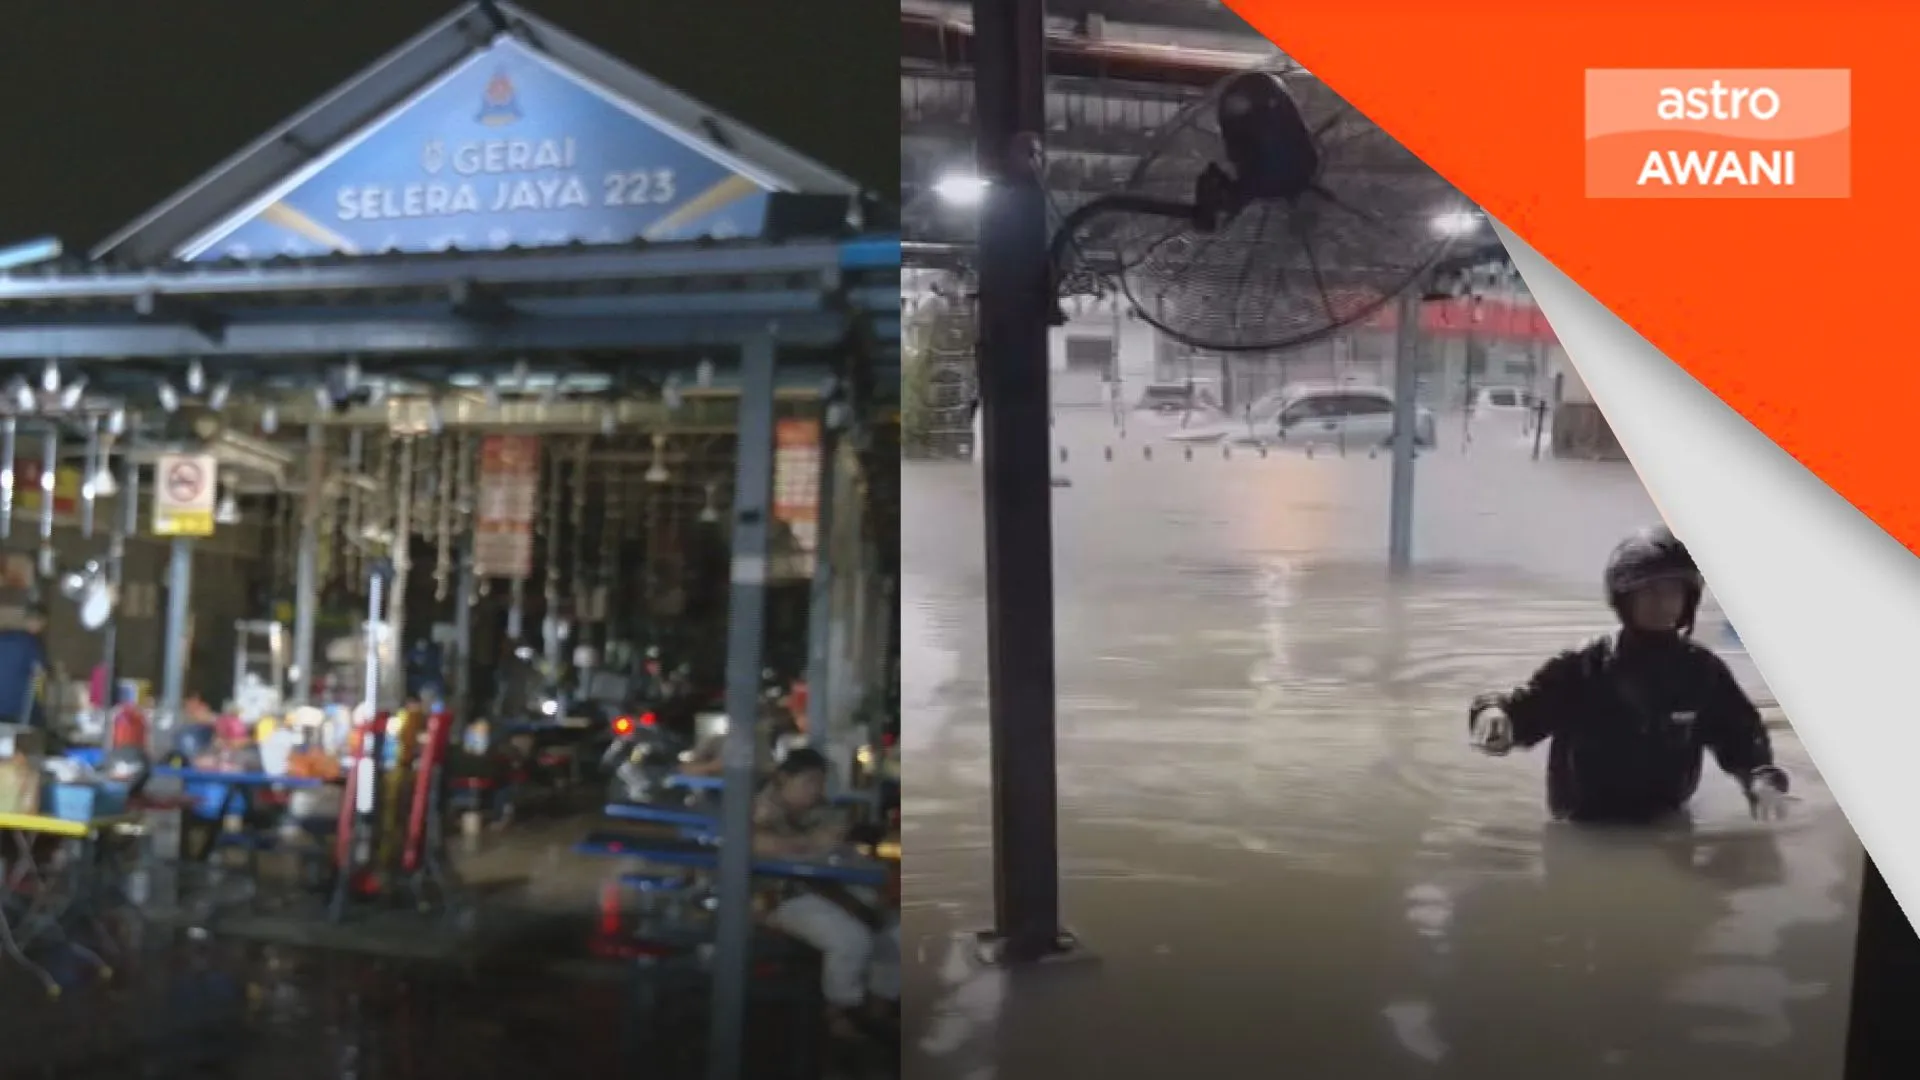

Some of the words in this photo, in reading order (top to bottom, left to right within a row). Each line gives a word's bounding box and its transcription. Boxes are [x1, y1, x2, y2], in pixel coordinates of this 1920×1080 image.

[452, 136, 576, 175] GERAI
[336, 182, 478, 221] SELERA
[489, 177, 589, 212] JAYA
[603, 168, 677, 207] 223
